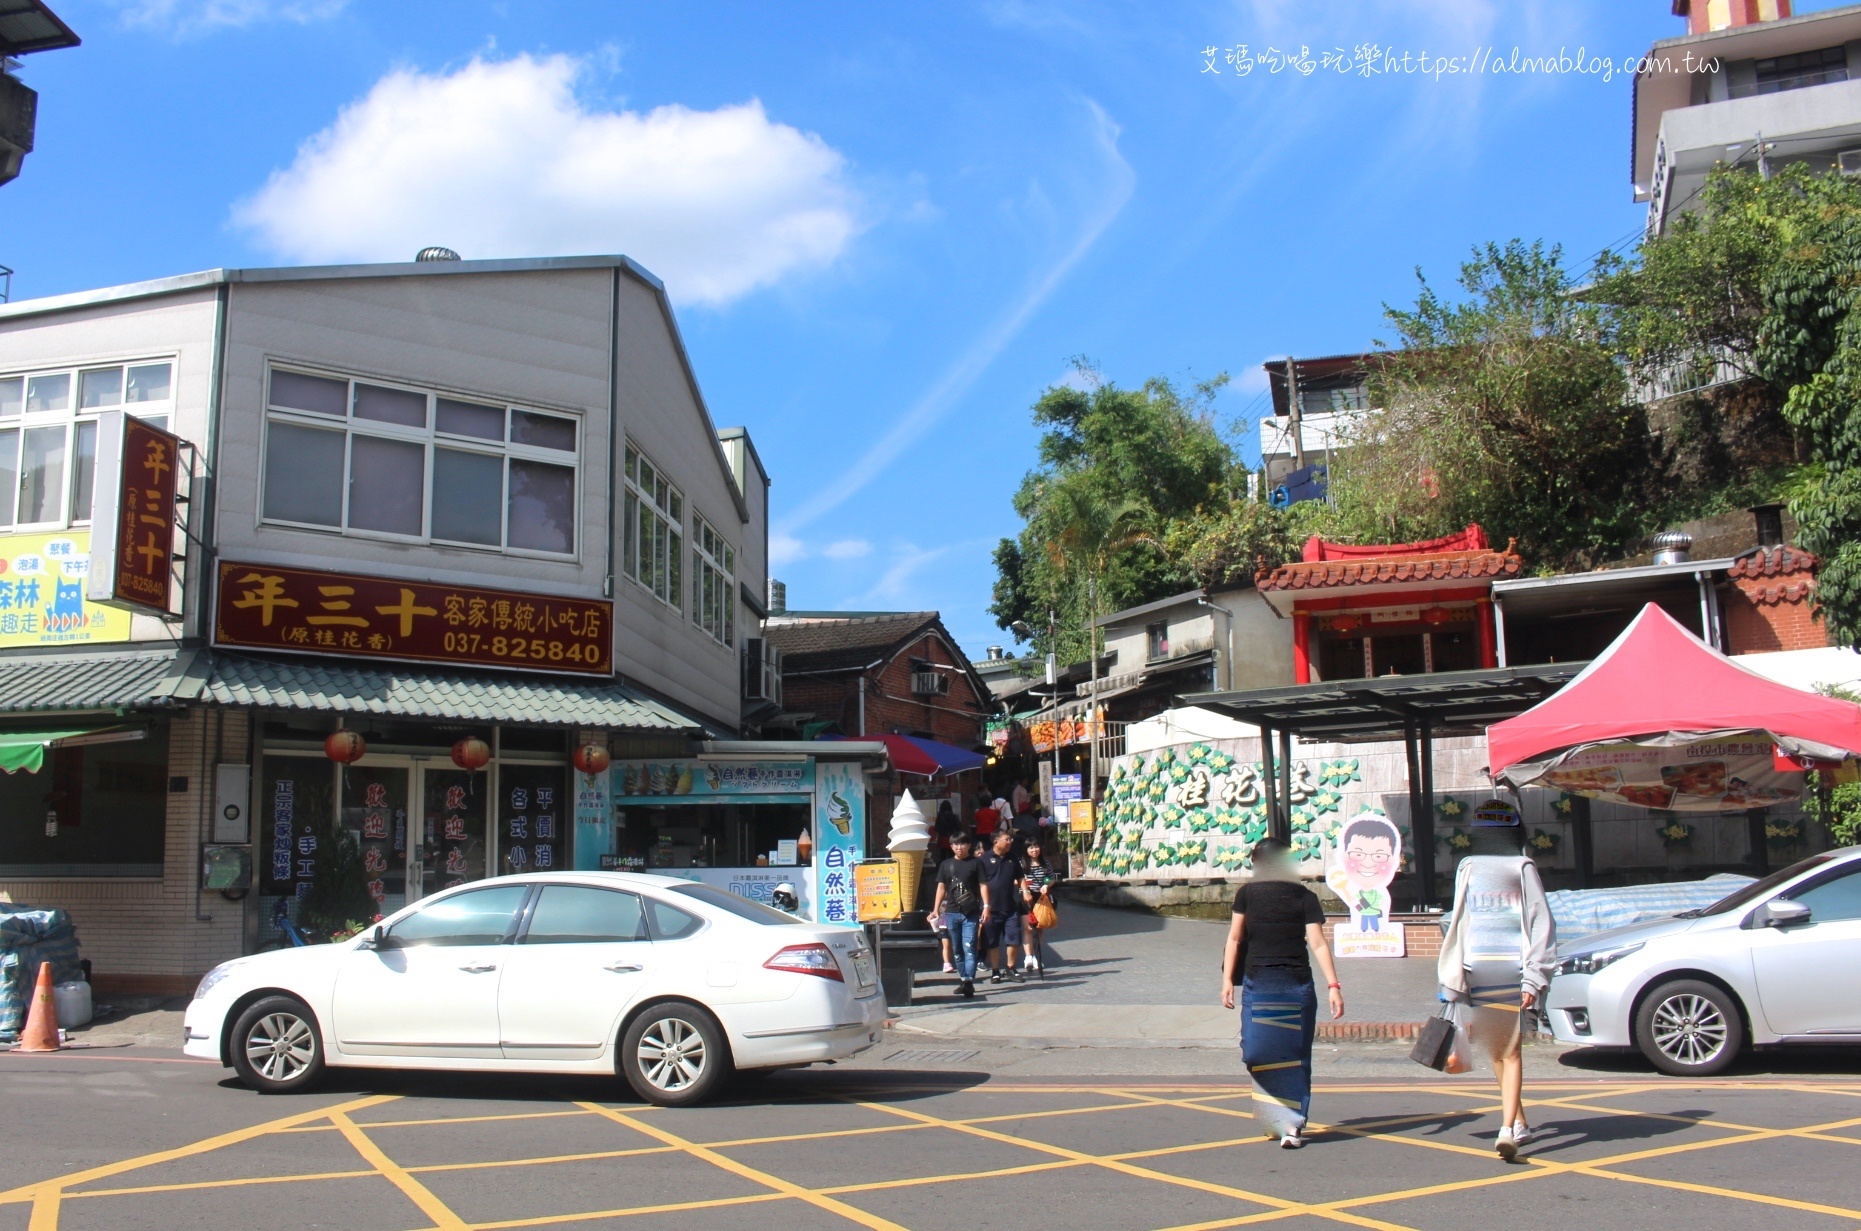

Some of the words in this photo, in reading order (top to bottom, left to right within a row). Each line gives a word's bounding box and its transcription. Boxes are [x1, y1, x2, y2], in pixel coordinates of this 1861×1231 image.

[137, 439, 170, 575] 年三十
[18, 558, 39, 570] 泡湯
[49, 543, 71, 555] 聚餐
[232, 572, 438, 637] 年三十
[443, 593, 601, 639] 客家傳統小吃店
[444, 632, 600, 664] 037-825840
[272, 780, 294, 881] 正宗客家炒粄條
[445, 785, 468, 888] 歡迎光
